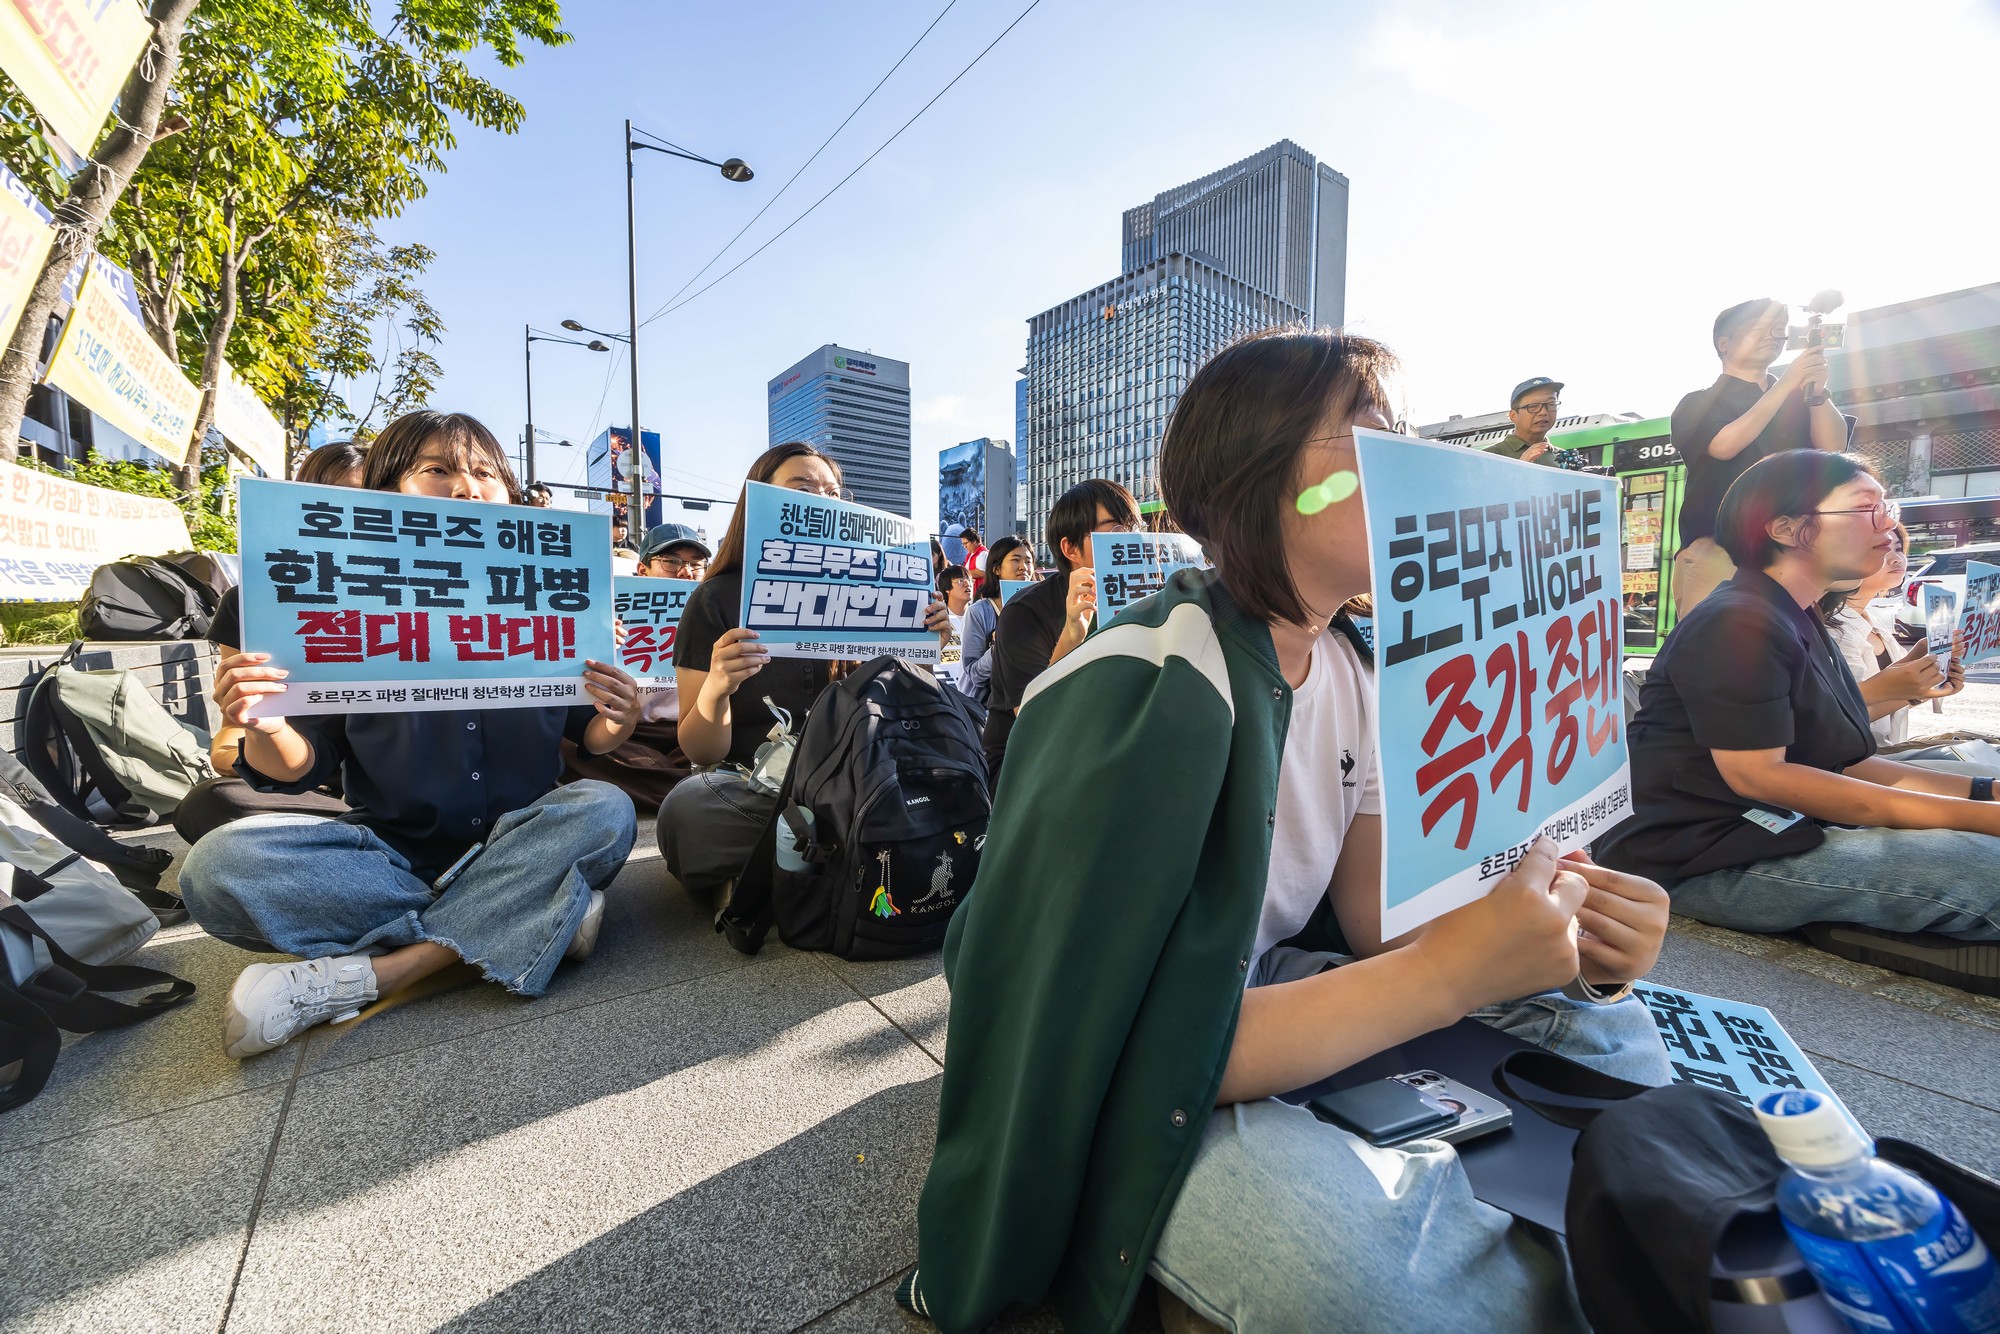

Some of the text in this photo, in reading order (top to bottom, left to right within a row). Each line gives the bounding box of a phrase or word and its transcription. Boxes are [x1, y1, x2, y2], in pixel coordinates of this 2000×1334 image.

[1201, 181, 1222, 197] HOTEL
[298, 501, 572, 558] 호르무즈 해협
[780, 503, 837, 540] 청년들이
[758, 540, 928, 582] 호르무즈 파병
[1111, 543, 1170, 566] 호르무즈
[264, 548, 591, 612] 한국군 파병
[1385, 489, 1602, 668] 호르무즈 파병검토
[748, 581, 929, 629] 반대한다
[295, 609, 576, 663] 절대 반대!
[794, 641, 828, 653] 호르무즈
[829, 643, 845, 654] 파병
[846, 644, 876, 656] 절대반대
[907, 648, 937, 659] 긴급집회
[306, 683, 577, 704] 호르무즈 파병 절대반대 청년학생 긴급집회
[1416, 597, 1619, 851] 즉각 중단!
[906, 796, 930, 806] KANGOL
[1580, 796, 1607, 832] 청년학생
[1607, 783, 1629, 815] 긴급집회
